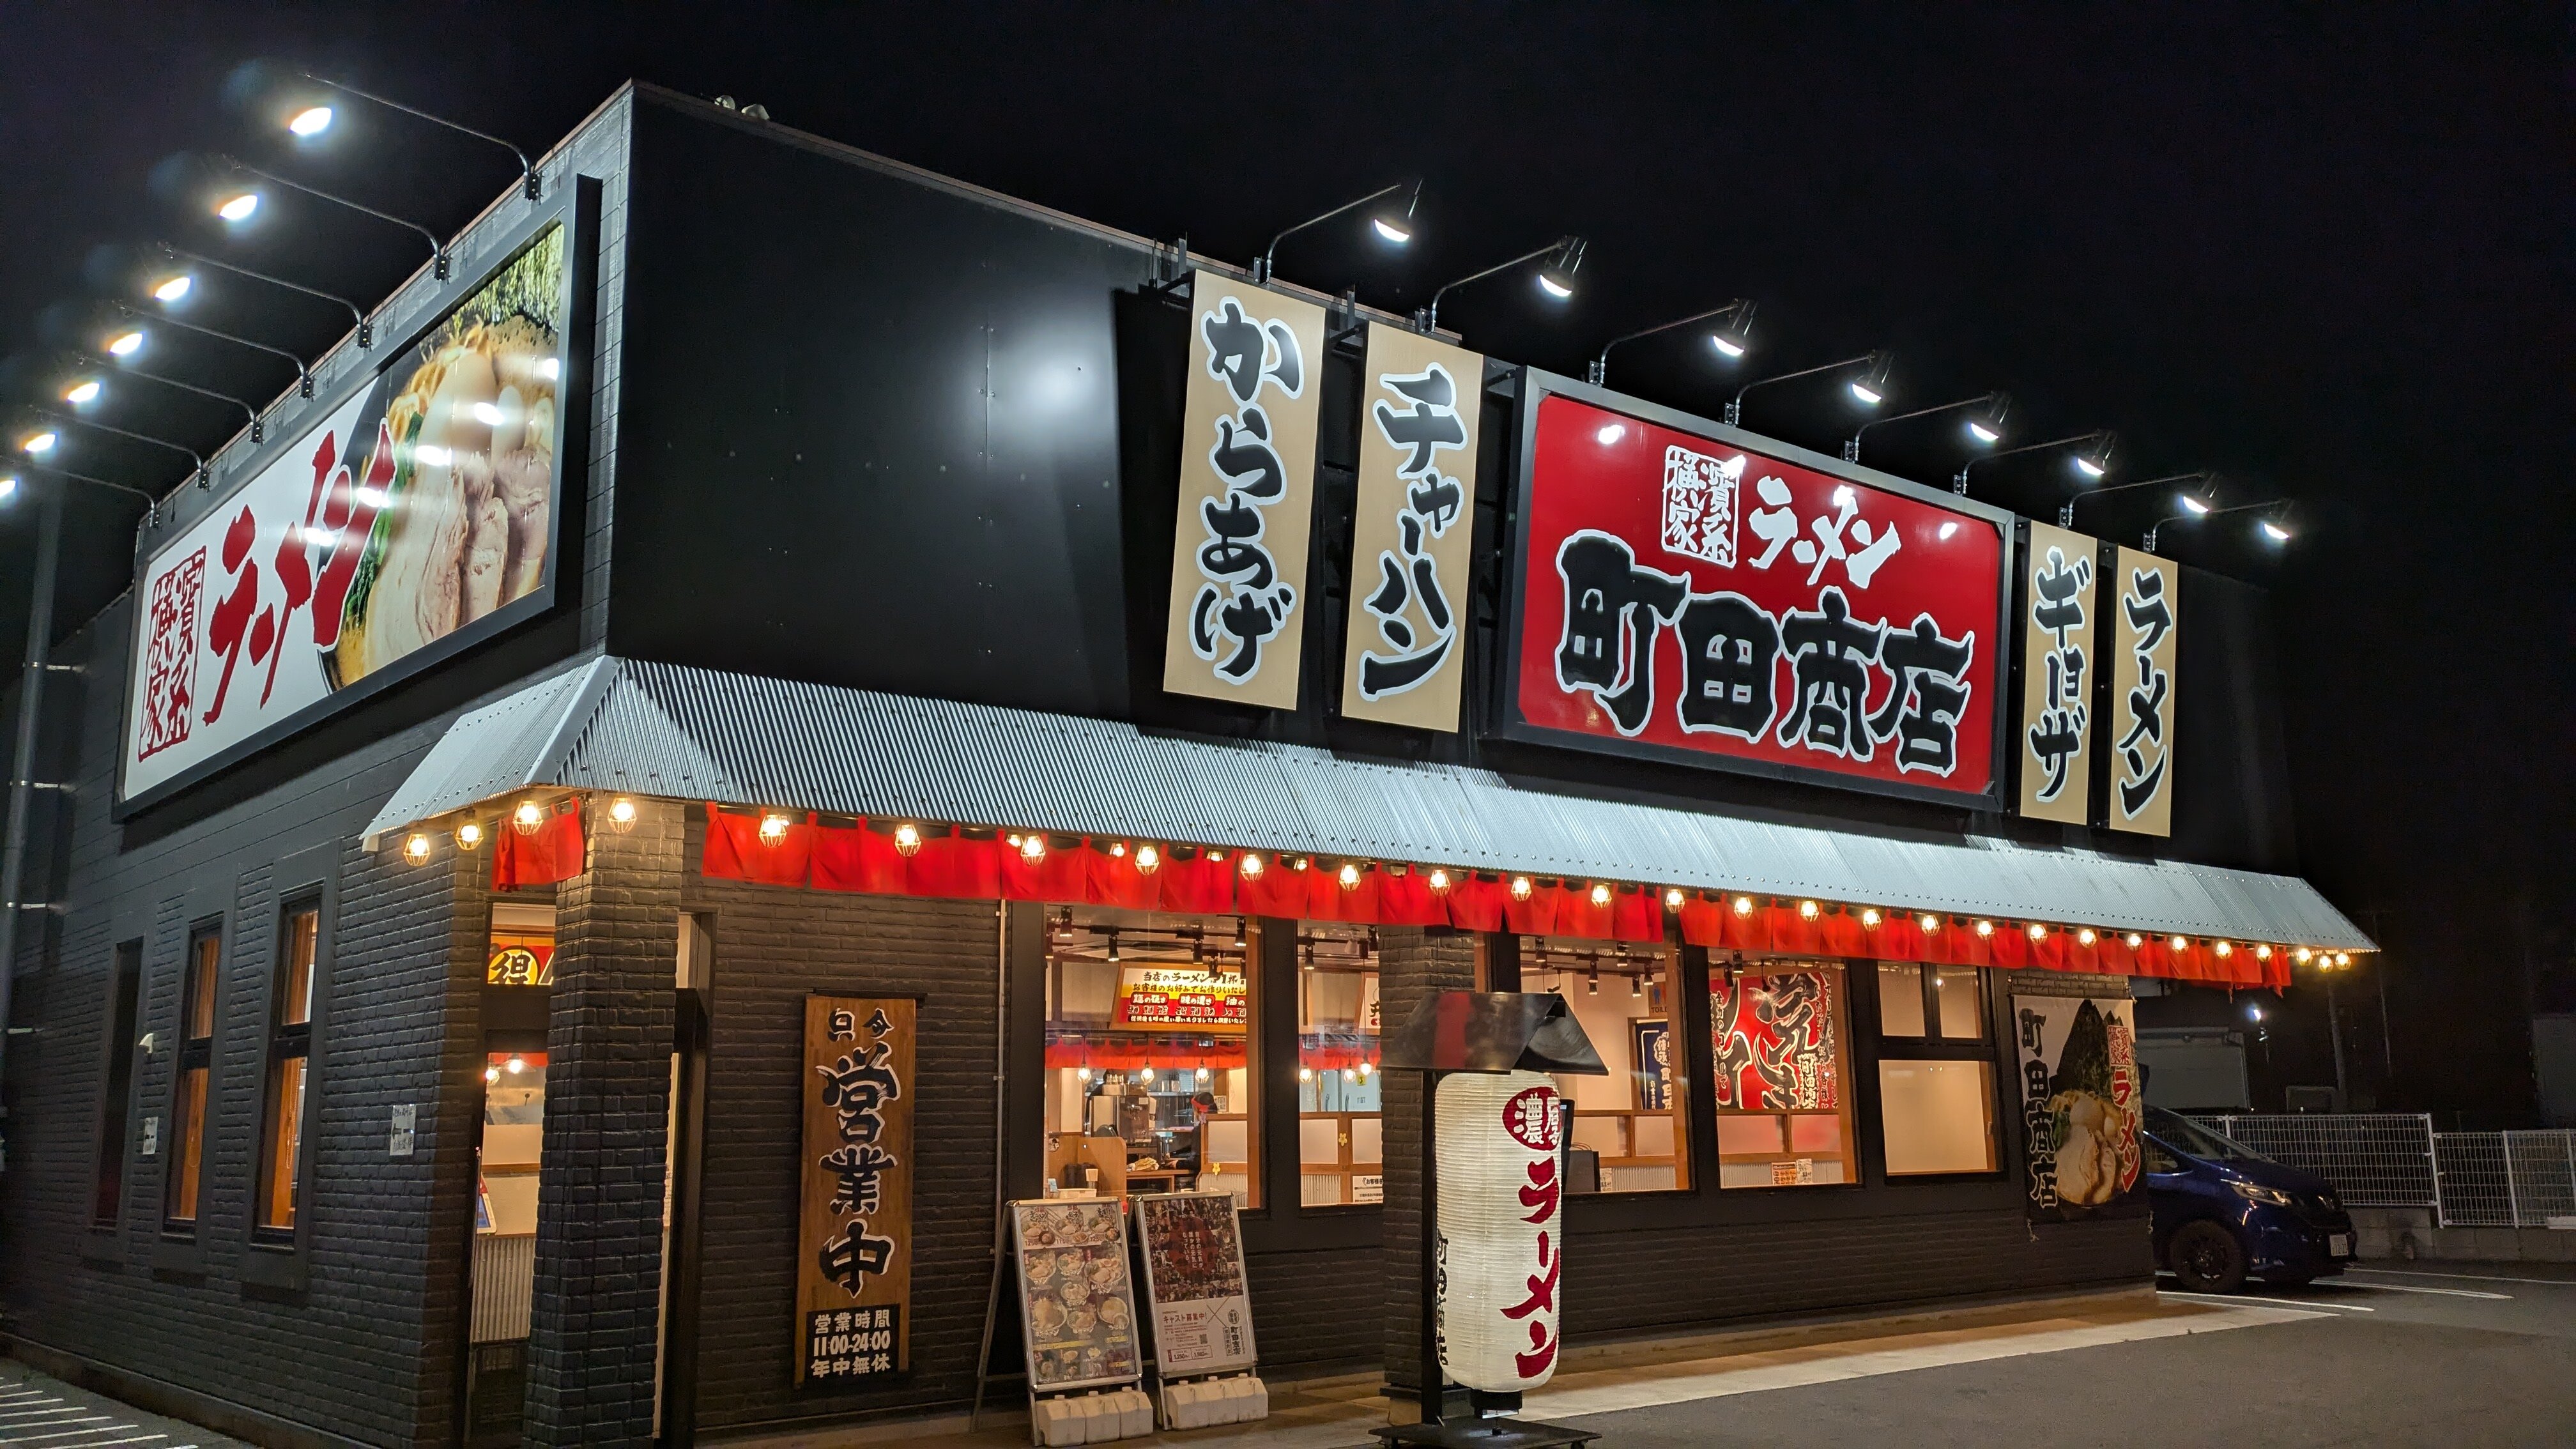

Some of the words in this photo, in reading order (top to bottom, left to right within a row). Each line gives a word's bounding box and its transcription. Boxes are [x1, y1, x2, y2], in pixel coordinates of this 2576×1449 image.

[1189, 295, 1305, 686] からあげ
[1358, 362, 1468, 702] チャーハン
[1749, 475, 1901, 589] ラーメン
[1555, 528, 1974, 778] 町田商店
[2028, 546, 2092, 803] ギョーザ
[2117, 567, 2173, 820] ラーメン
[828, 1008, 894, 1041] 只今
[2018, 1008, 2058, 1209] 町田商店
[2112, 1070, 2141, 1193] ラーメン
[815, 1041, 901, 1300] 営業中
[1499, 1156, 1561, 1379] ラーメン
[811, 1354, 891, 1378] 年中無休
[815, 1309, 891, 1334] 営業時間
